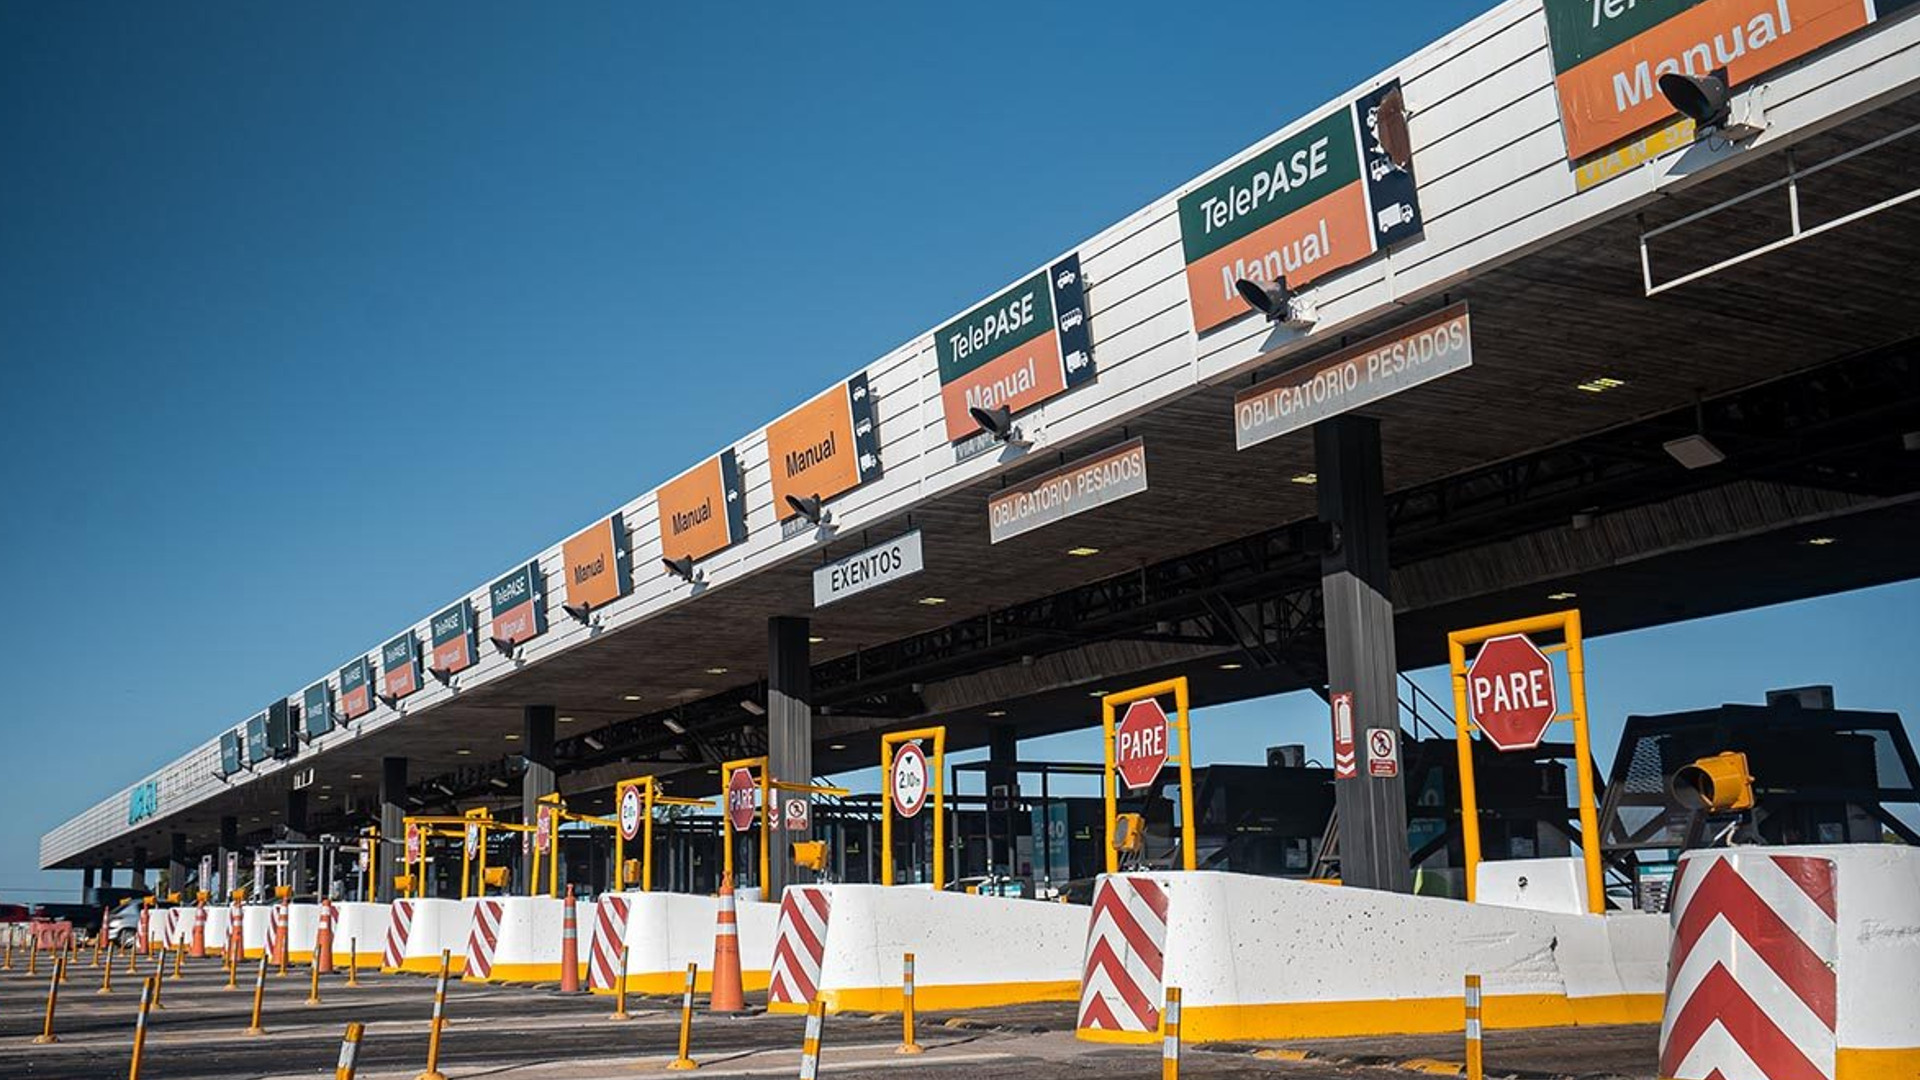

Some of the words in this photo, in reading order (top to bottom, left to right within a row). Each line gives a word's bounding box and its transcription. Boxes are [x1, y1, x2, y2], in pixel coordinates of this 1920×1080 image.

[1200, 136, 1330, 234] TelePASE
[1221, 219, 1331, 301] Manual
[949, 292, 1035, 363] TelePASE
[964, 357, 1036, 414] Manual
[1239, 362, 1359, 430] OBLIGATORIO
[1367, 320, 1464, 383] PESADOS
[785, 431, 837, 479] Manual
[992, 478, 1073, 527] OBLIGATORIO
[1077, 452, 1142, 498] PESADOS
[672, 496, 712, 536] Manual
[574, 552, 605, 586] Manual
[830, 543, 904, 593] EXENTOS
[1475, 669, 1548, 716] PARE
[1120, 724, 1165, 761] PARE
[730, 788, 754, 811] PARE
